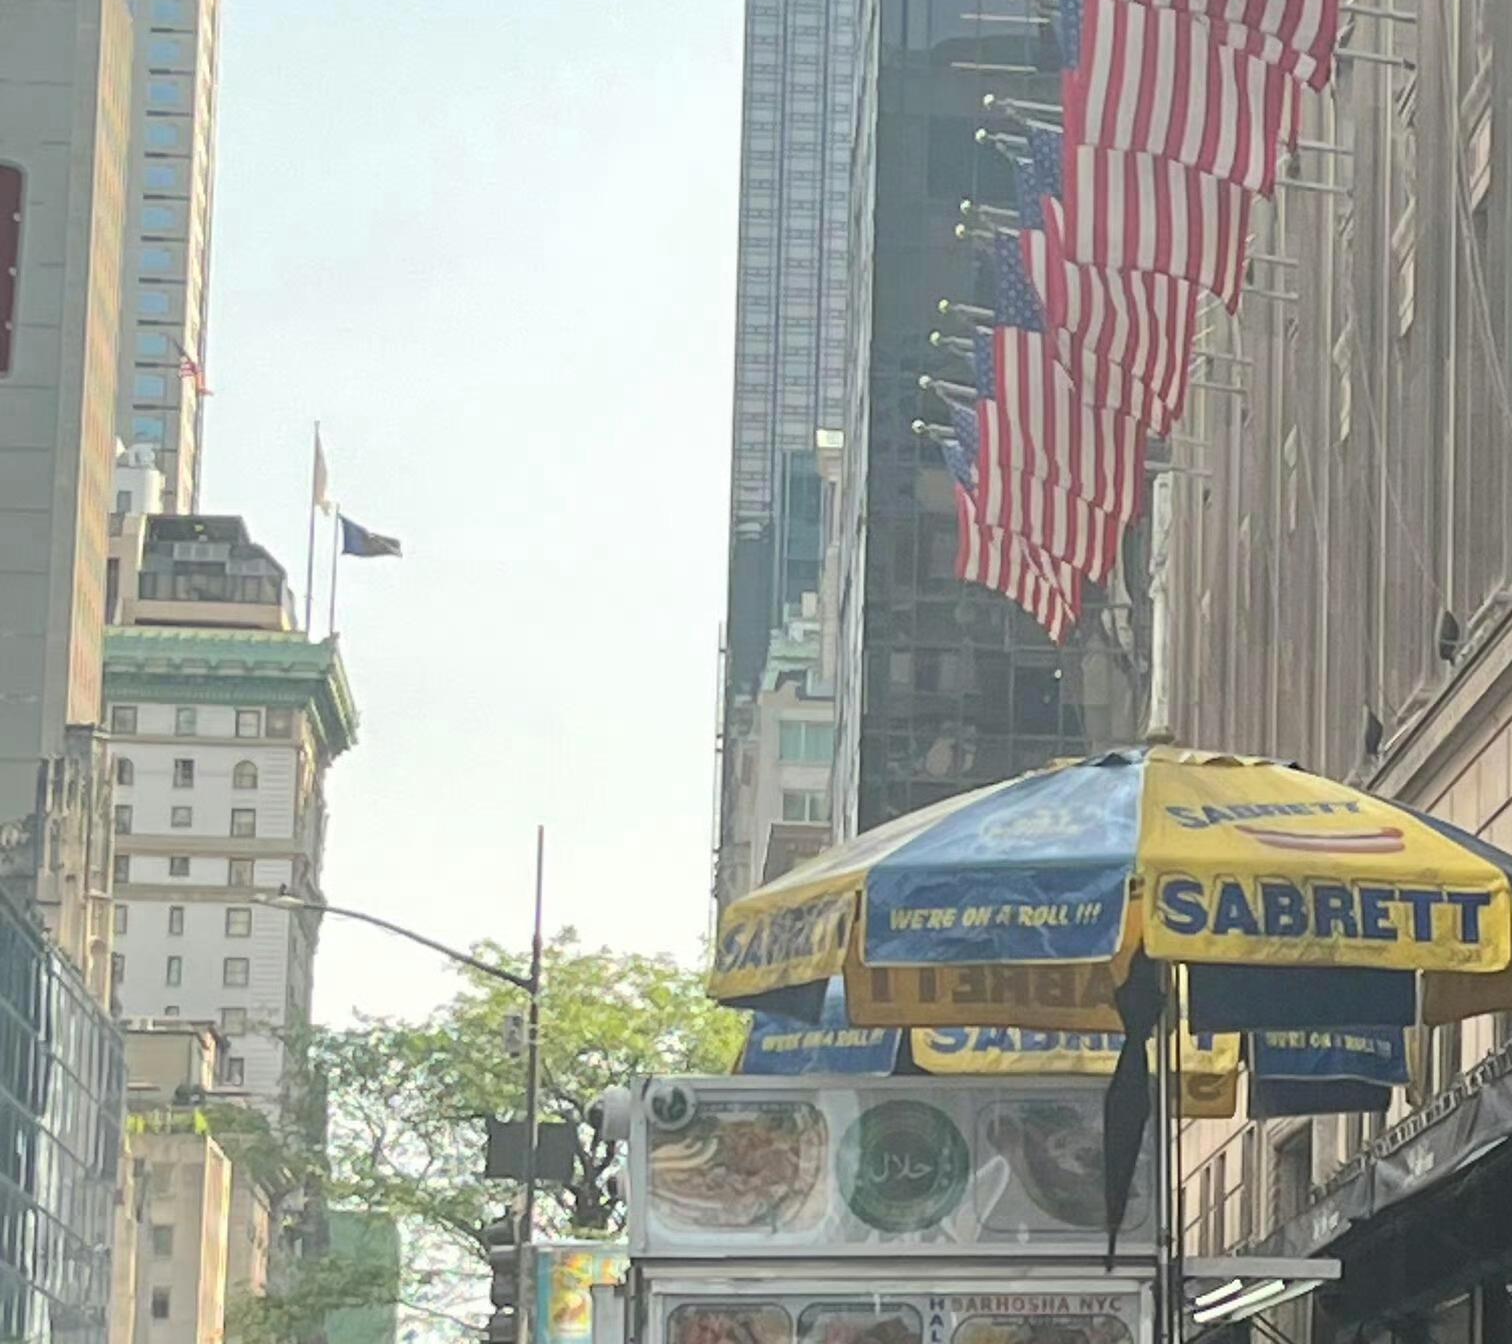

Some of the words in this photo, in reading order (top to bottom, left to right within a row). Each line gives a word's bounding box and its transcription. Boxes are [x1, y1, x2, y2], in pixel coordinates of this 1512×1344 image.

[1165, 800, 1361, 830] SABRETT
[889, 907, 954, 931] WE'RE
[961, 907, 990, 927] ON
[1019, 903, 1069, 927] ROLL
[1160, 877, 1492, 944] SABRETT
[1079, 1296, 1122, 1313] NYC
